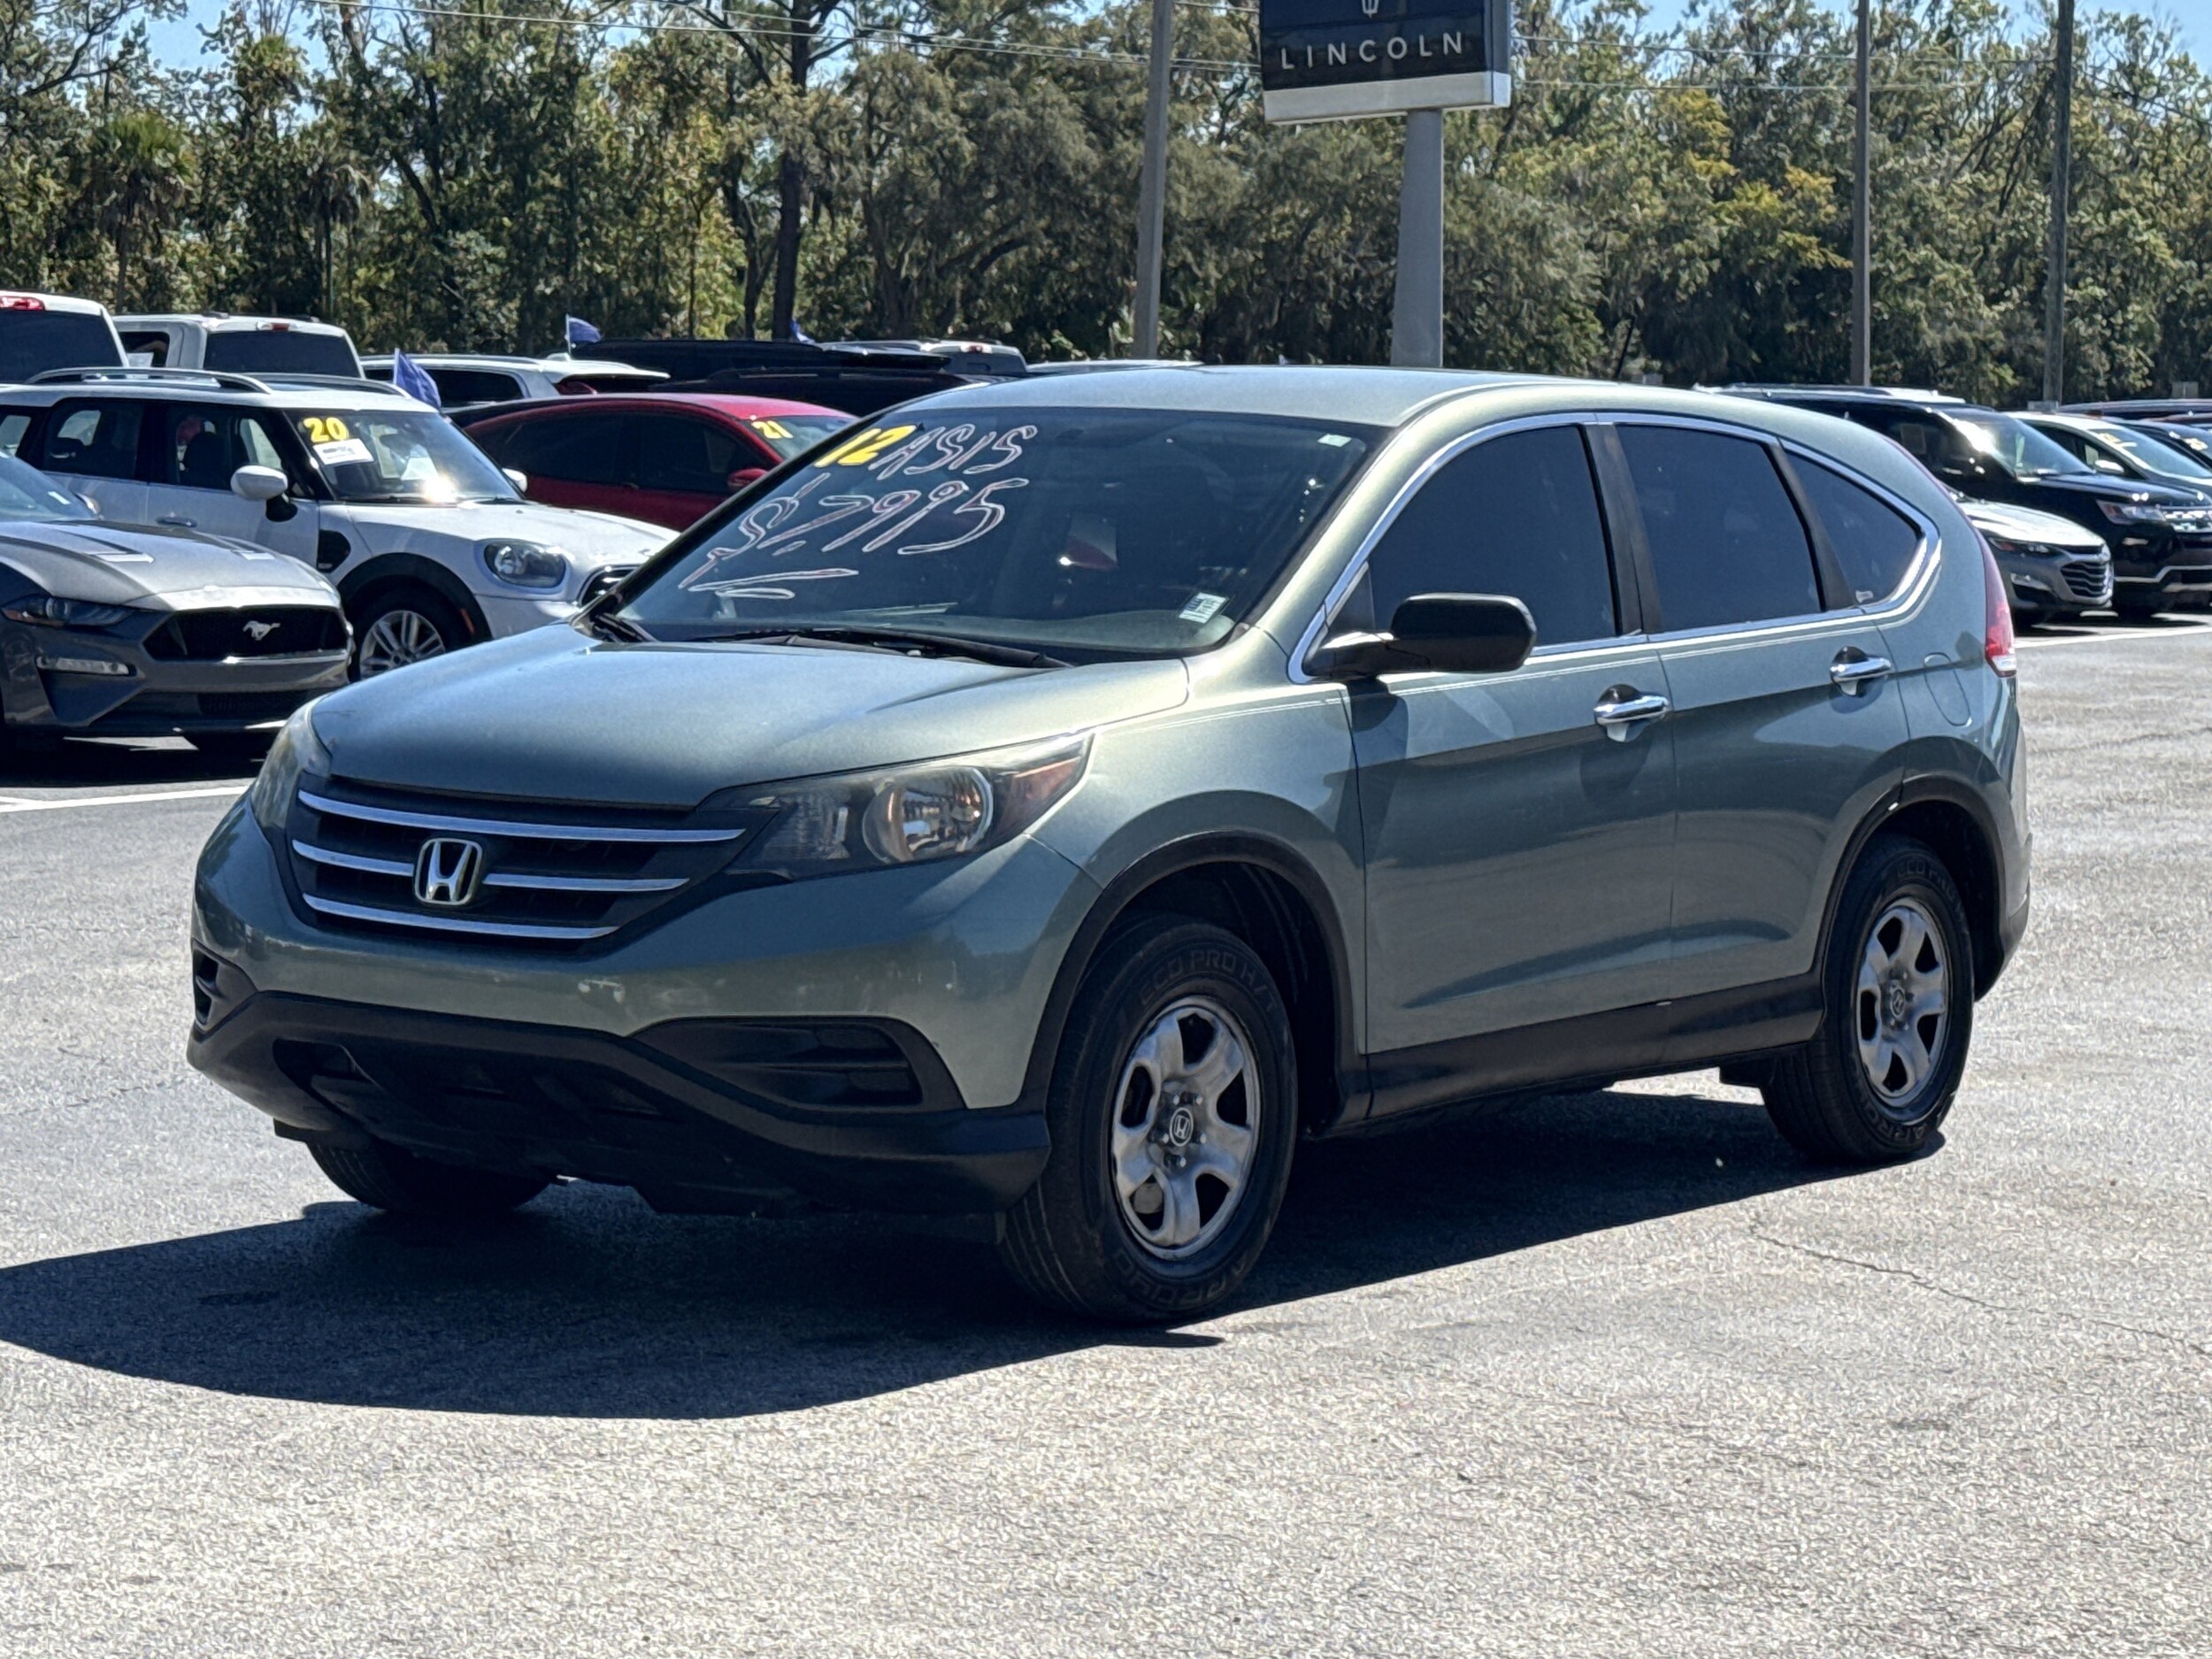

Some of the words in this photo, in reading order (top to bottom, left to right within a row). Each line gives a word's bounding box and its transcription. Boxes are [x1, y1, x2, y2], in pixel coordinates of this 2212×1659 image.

[1281, 31, 1462, 70] LINCOLN
[303, 417, 349, 442] 20
[751, 420, 794, 439] 21
[813, 425, 918, 467] 12
[1191, 949, 1237, 974] PRO
